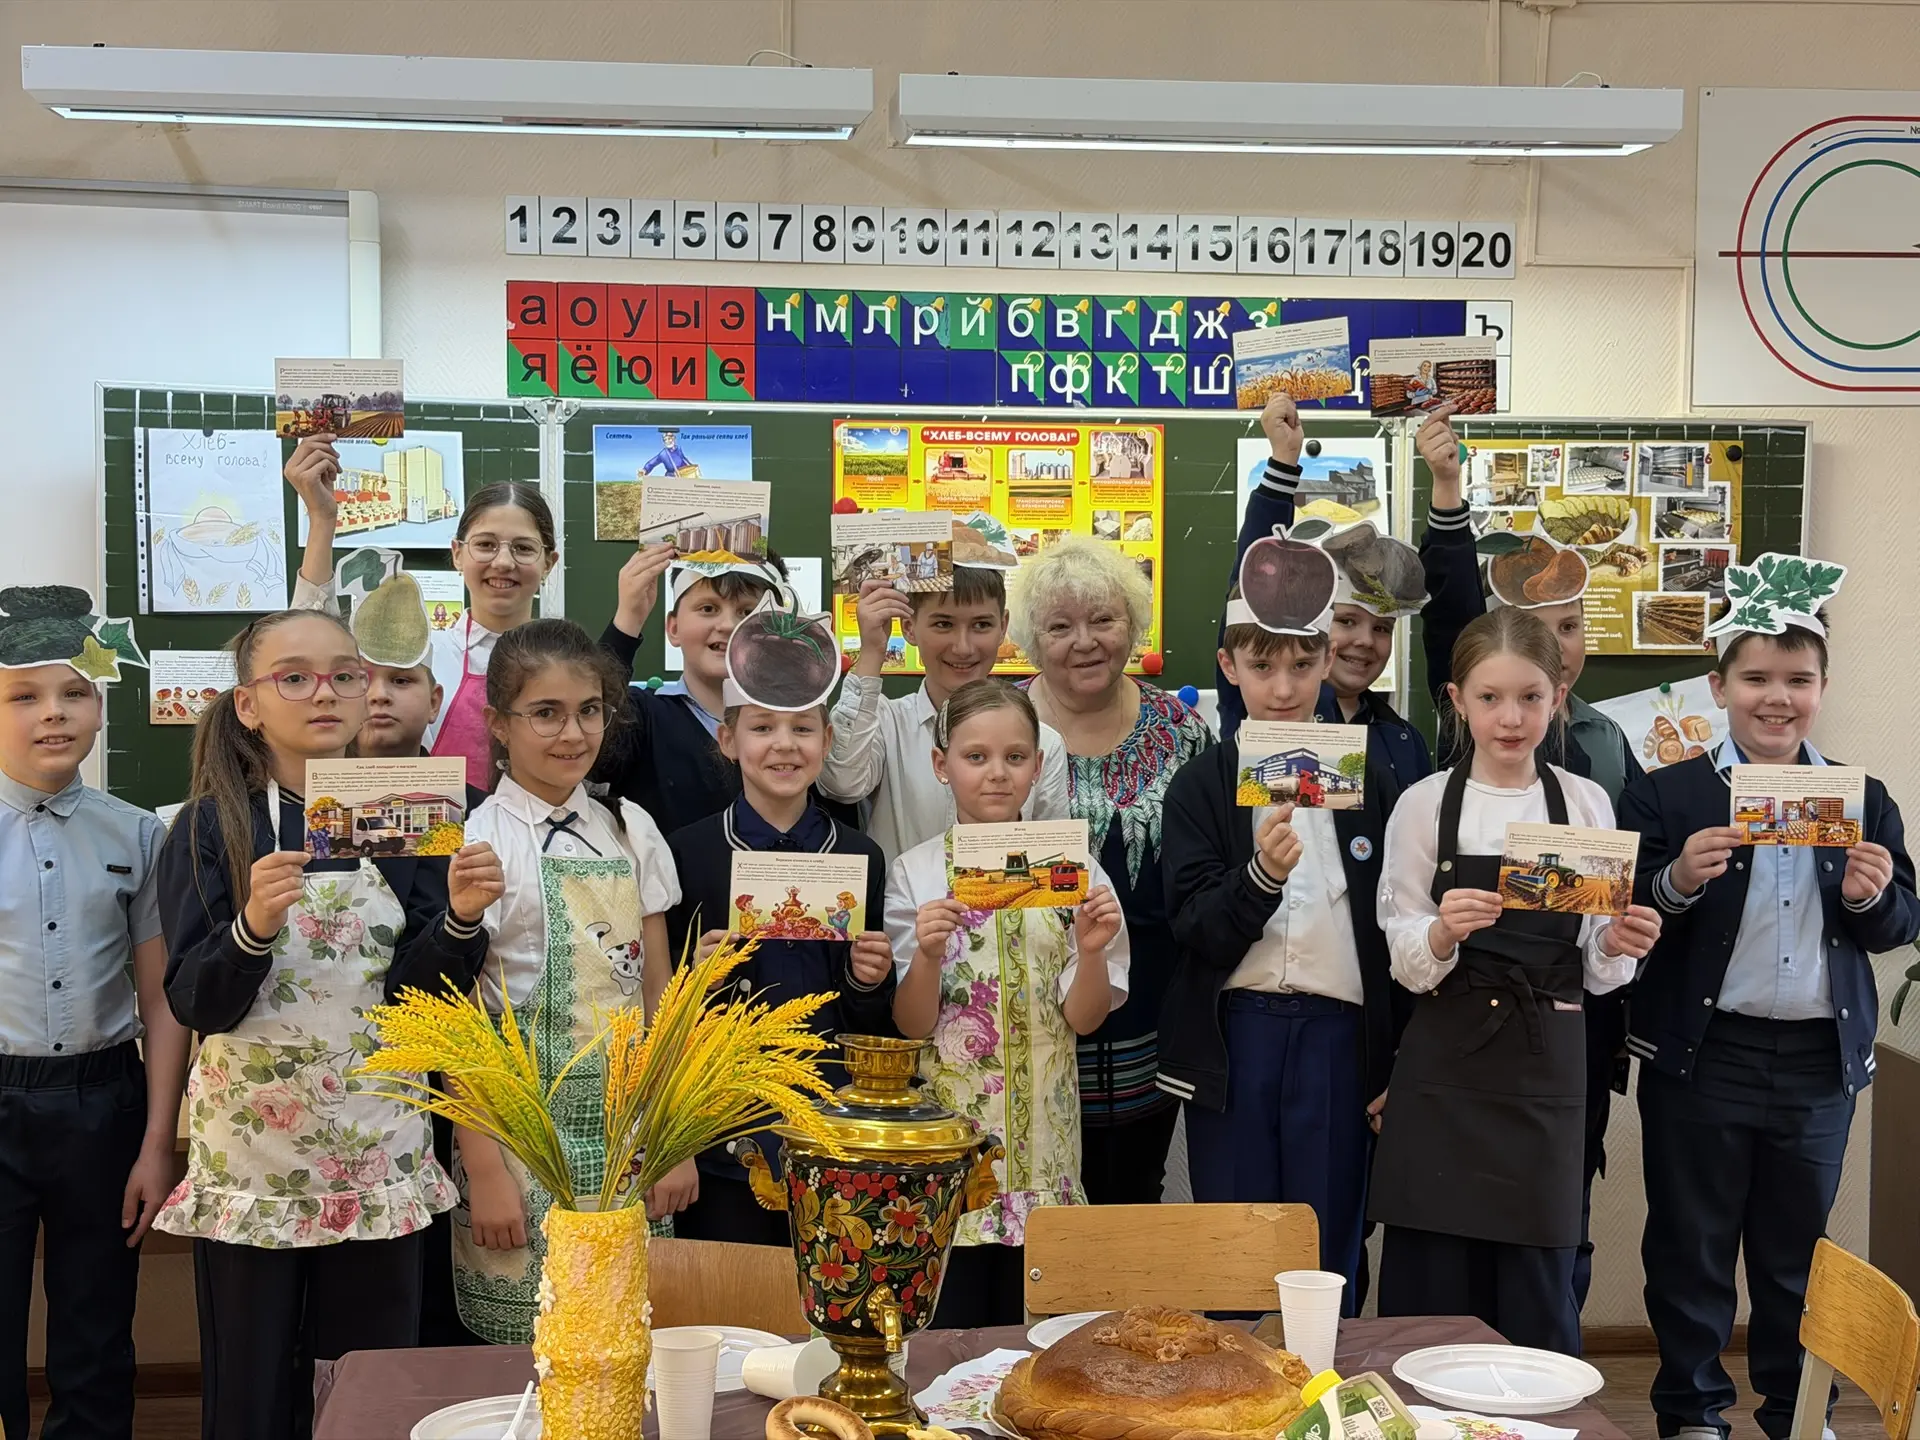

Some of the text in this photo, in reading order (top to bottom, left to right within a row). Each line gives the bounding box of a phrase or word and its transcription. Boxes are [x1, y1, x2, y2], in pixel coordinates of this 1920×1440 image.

[509, 205, 1511, 269] 1 2 3 4 5 6 7 8 9 10 11 12 13 14 15 16 17 18 19 20
[520, 295, 546, 325] а
[570, 297, 597, 327] о
[621, 298, 648, 338] у
[668, 300, 700, 329] ы
[719, 301, 745, 329] э
[767, 304, 791, 331] н
[816, 304, 846, 332] м
[863, 305, 890, 334] л
[914, 305, 939, 345] р
[961, 297, 985, 336] й
[1008, 298, 1034, 337] б
[1057, 308, 1080, 337] в
[1106, 310, 1124, 338] г
[1149, 310, 1179, 346] д
[1193, 311, 1228, 339] ж
[522, 353, 545, 382] я
[570, 344, 597, 383] ё
[617, 355, 652, 385] ю
[672, 356, 695, 385] и
[719, 357, 746, 387] е
[1013, 363, 1036, 393] п
[1050, 354, 1089, 402] ф
[1107, 365, 1127, 393] к
[1151, 366, 1174, 394] т
[1194, 366, 1230, 395] ш
[182, 432, 237, 451] Хлеб-
[1469, 446, 1477, 457] 3
[1552, 449, 1560, 458] 4
[1622, 450, 1630, 461] 5
[217, 449, 268, 469] голова!
[1705, 453, 1713, 465] 6
[1505, 516, 1513, 528] 2
[1725, 524, 1733, 535] 7
[1703, 640, 1711, 651] 9
